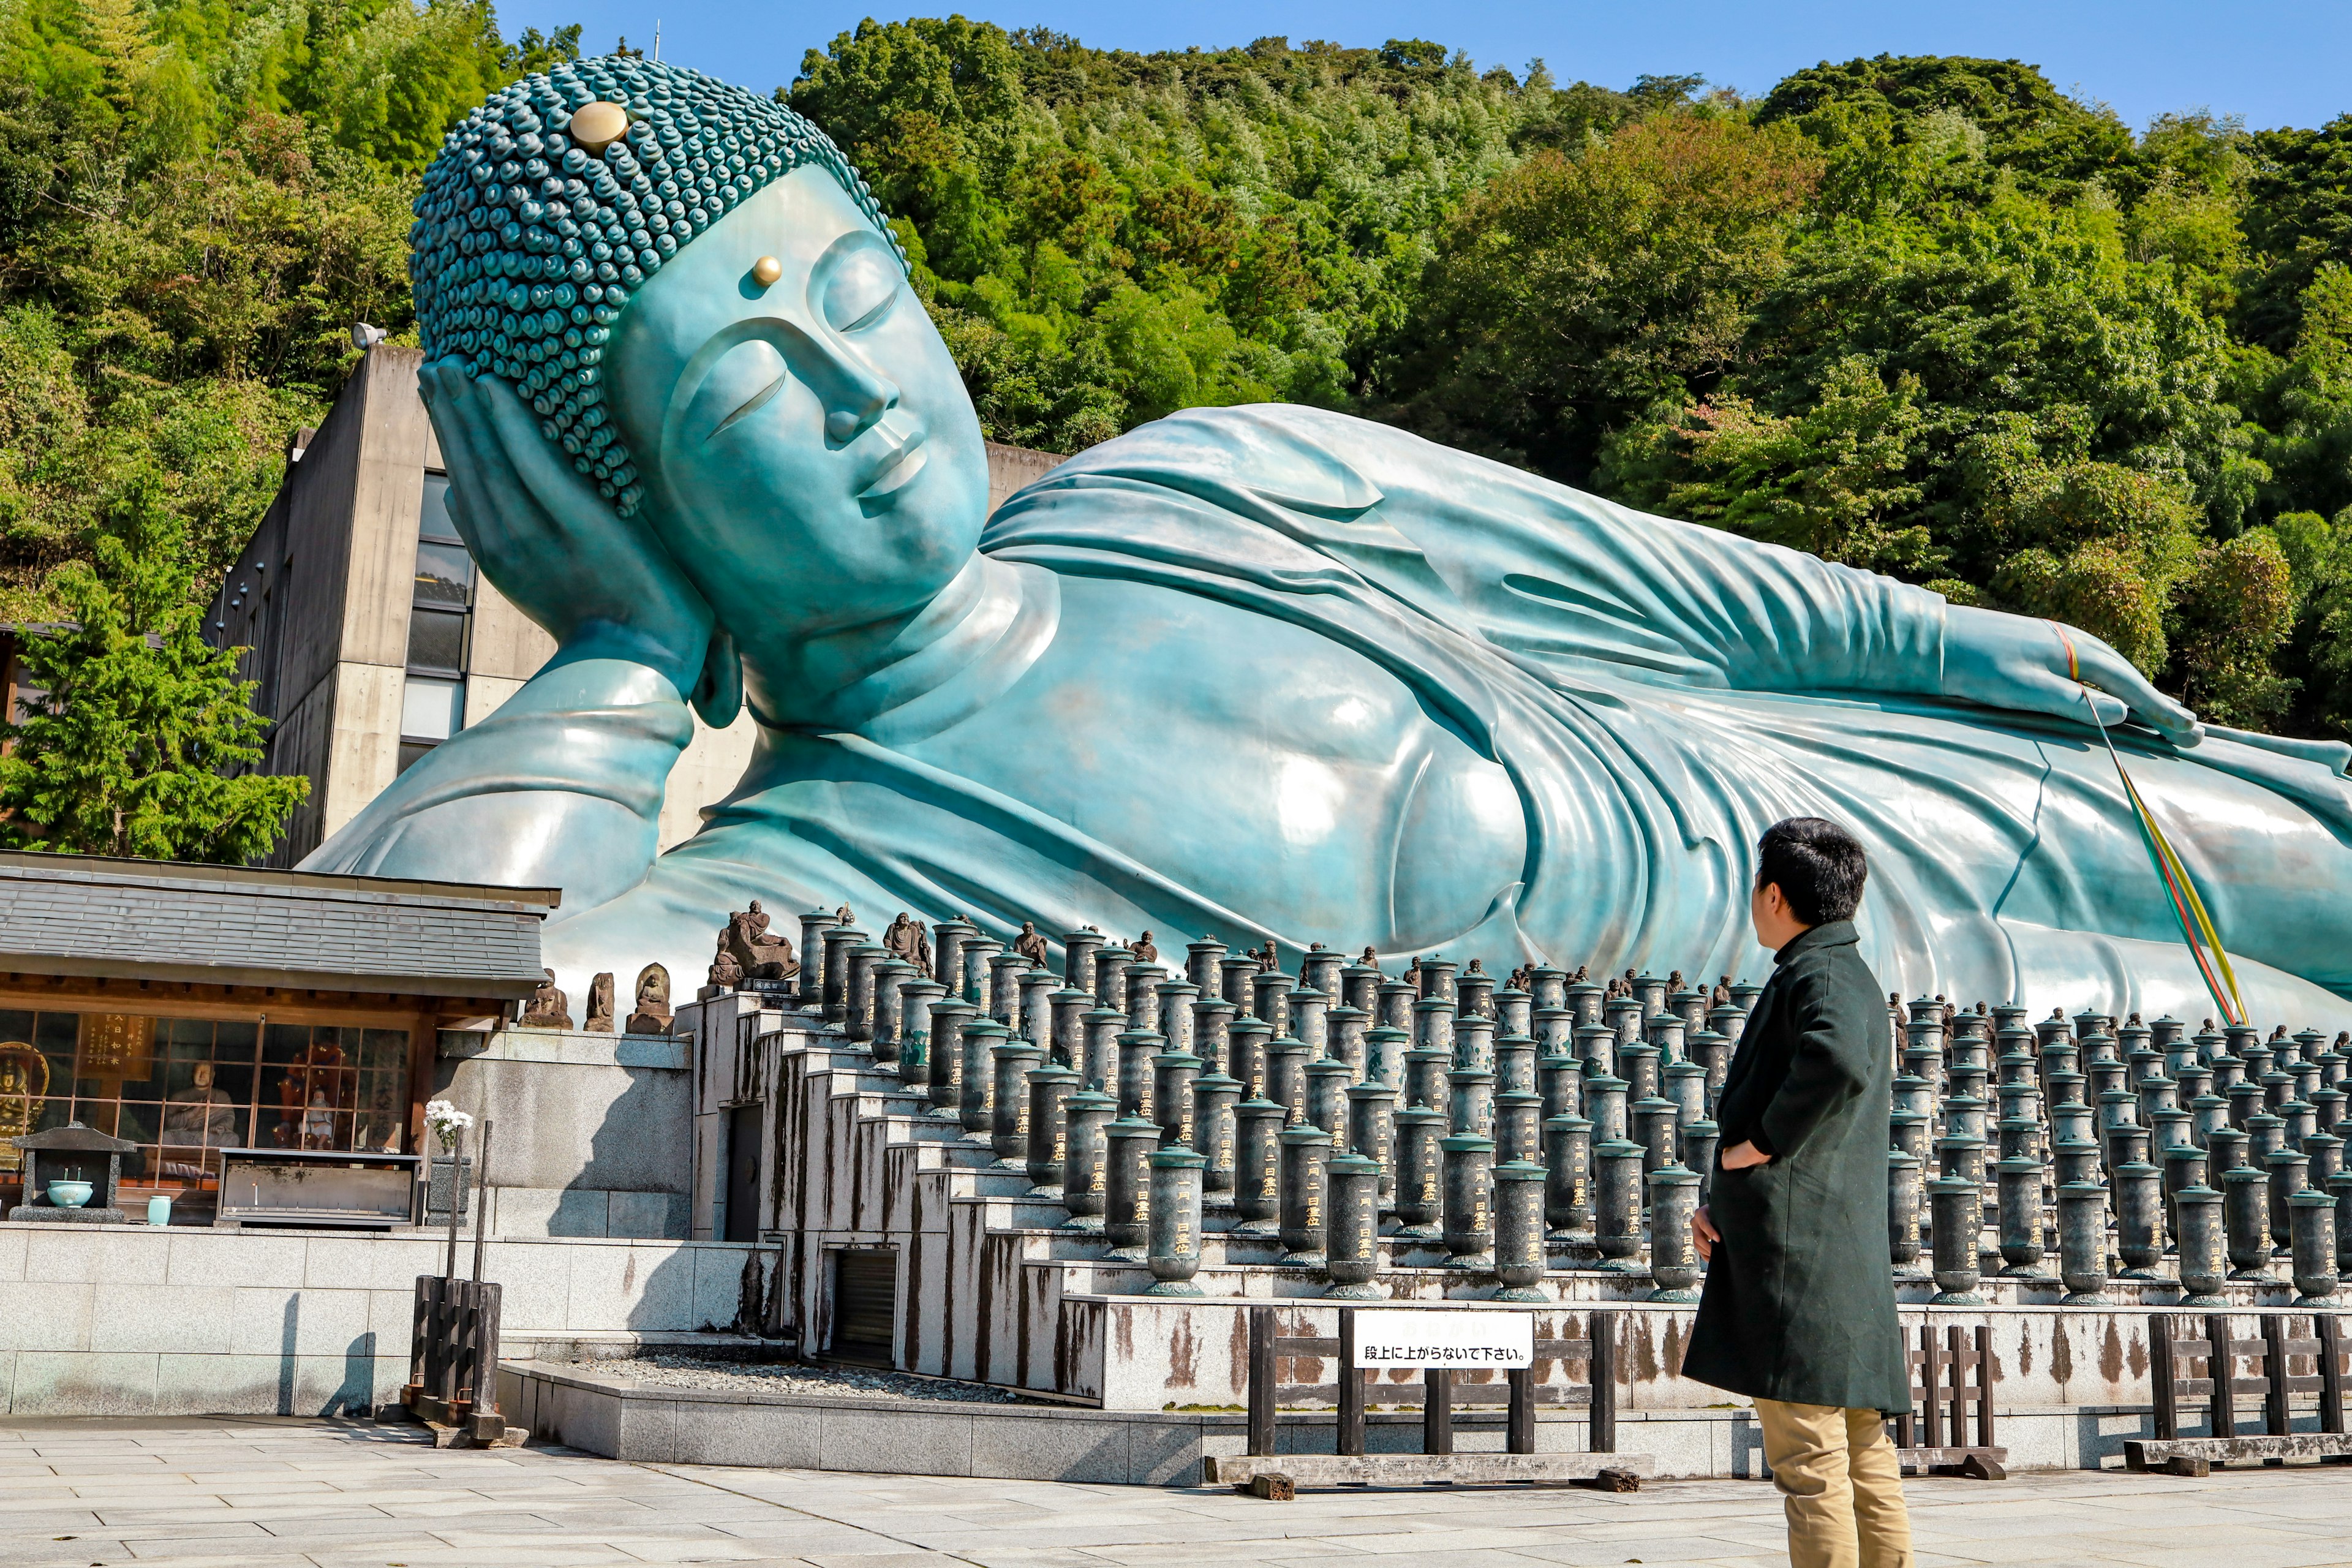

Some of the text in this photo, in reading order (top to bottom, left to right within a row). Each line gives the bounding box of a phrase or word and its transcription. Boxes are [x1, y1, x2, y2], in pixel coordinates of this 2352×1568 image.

[1219, 1102, 1233, 1167] 四月二日霊位
[1262, 1128, 1277, 1196] 三月二日霊位
[1134, 1150, 1150, 1221] 二月一日霊位
[1305, 1157, 1321, 1226] 二月二日霊位
[1422, 1136, 1436, 1201] 三月三日霊位
[1473, 1164, 1488, 1231] 二月三日霊位
[1572, 1142, 1586, 1206] 三月四日霊位
[1174, 1180, 1191, 1255] 一月一日霊位
[1357, 1189, 1374, 1259] 一月二日霊位
[1526, 1194, 1540, 1262] 一月三日霊位
[1627, 1169, 1640, 1234] 二月四日霊位
[1909, 1178, 1919, 1241] 二月六日霊位
[2031, 1184, 2042, 1244] 二月七日霊位
[2151, 1189, 2162, 1247] 二月八日霊位
[2259, 1192, 2270, 1249] 二月九日霊位
[1966, 1207, 1978, 1270] 一月六日霊位
[2094, 1211, 2106, 1271] 一月七日霊位
[2208, 1214, 2222, 1273] 一月八日霊位
[2324, 1217, 2336, 1275] 一月九日霊位
[1365, 1346, 1524, 1361] 段上に上がらないで下さい。
